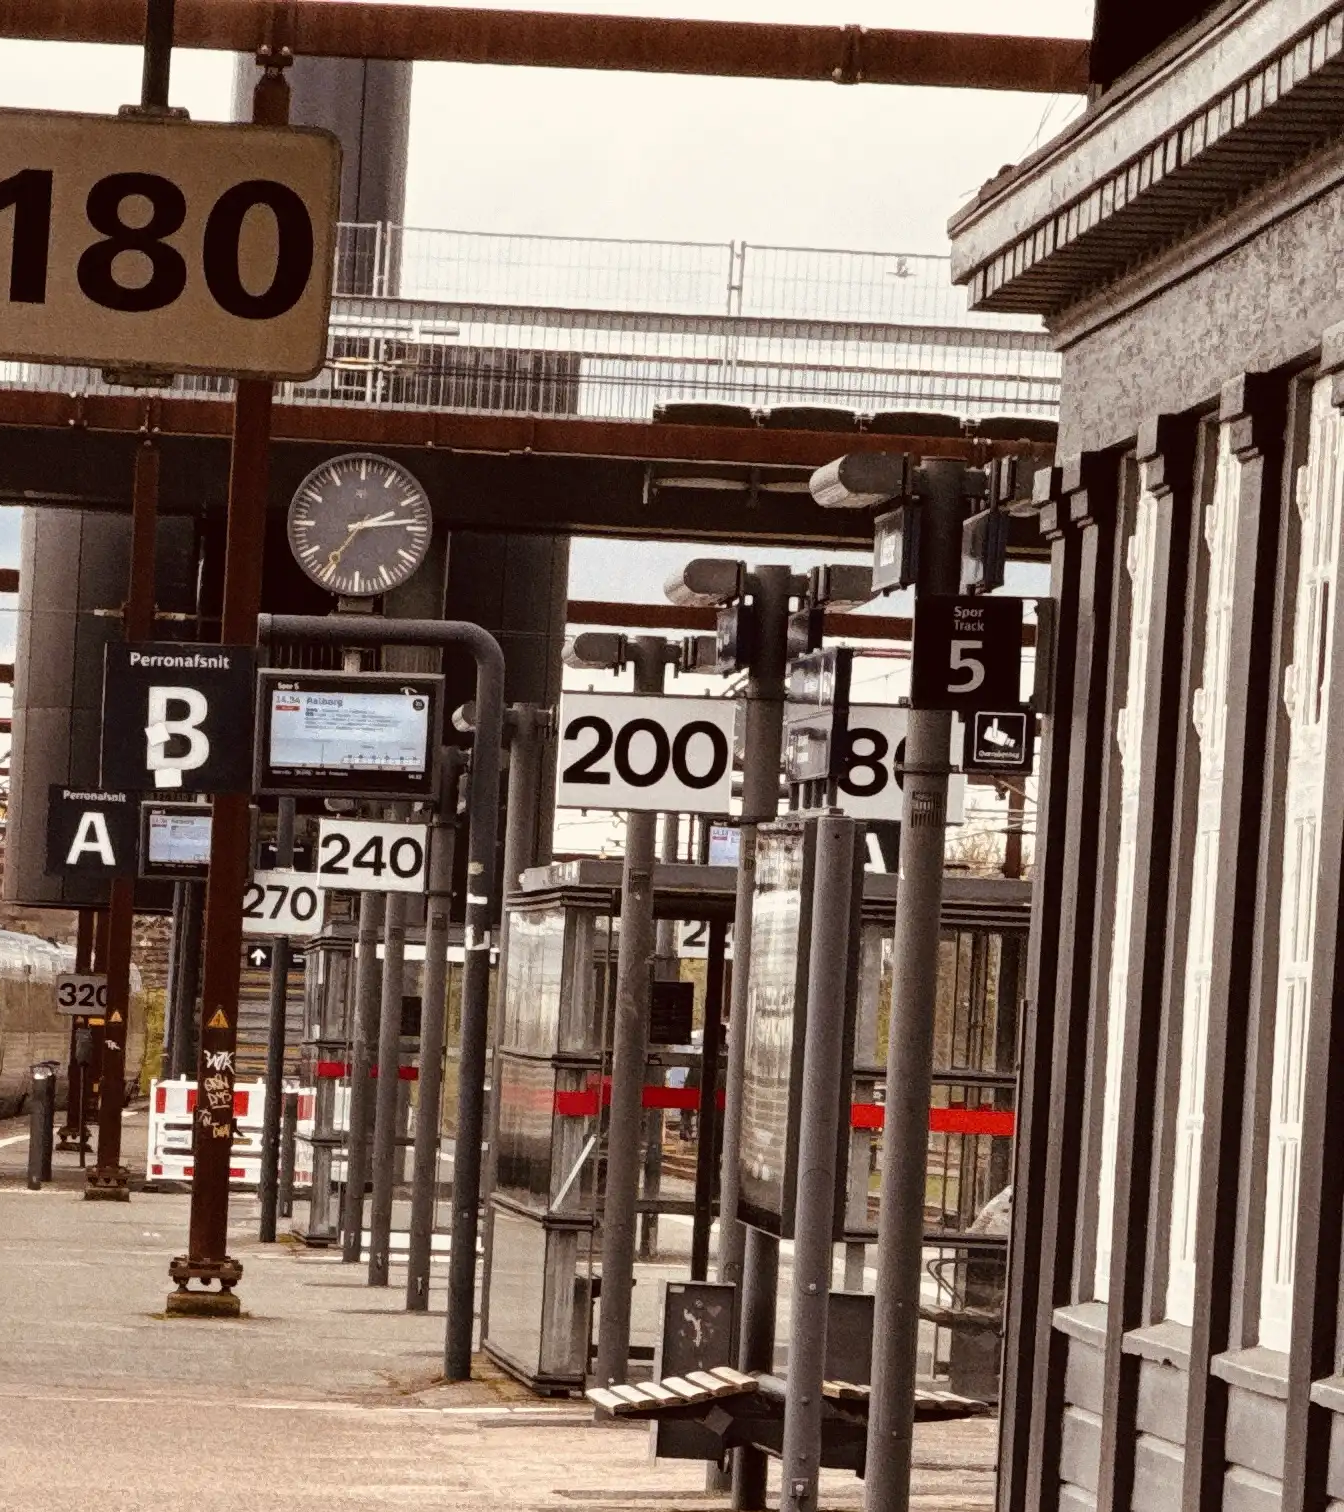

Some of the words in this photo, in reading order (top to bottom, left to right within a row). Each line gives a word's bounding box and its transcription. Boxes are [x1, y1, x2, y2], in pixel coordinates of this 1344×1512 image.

[954, 606, 985, 618] Spor
[954, 620, 985, 632] Track
[130, 652, 230, 669] Perronafsnit
[947, 640, 985, 693] 5
[146, 686, 210, 770] B
[563, 715, 729, 789] 200
[63, 789, 126, 803] Perronafsnit
[66, 812, 116, 866] A
[320, 833, 424, 878] 240
[242, 882, 318, 921] 270
